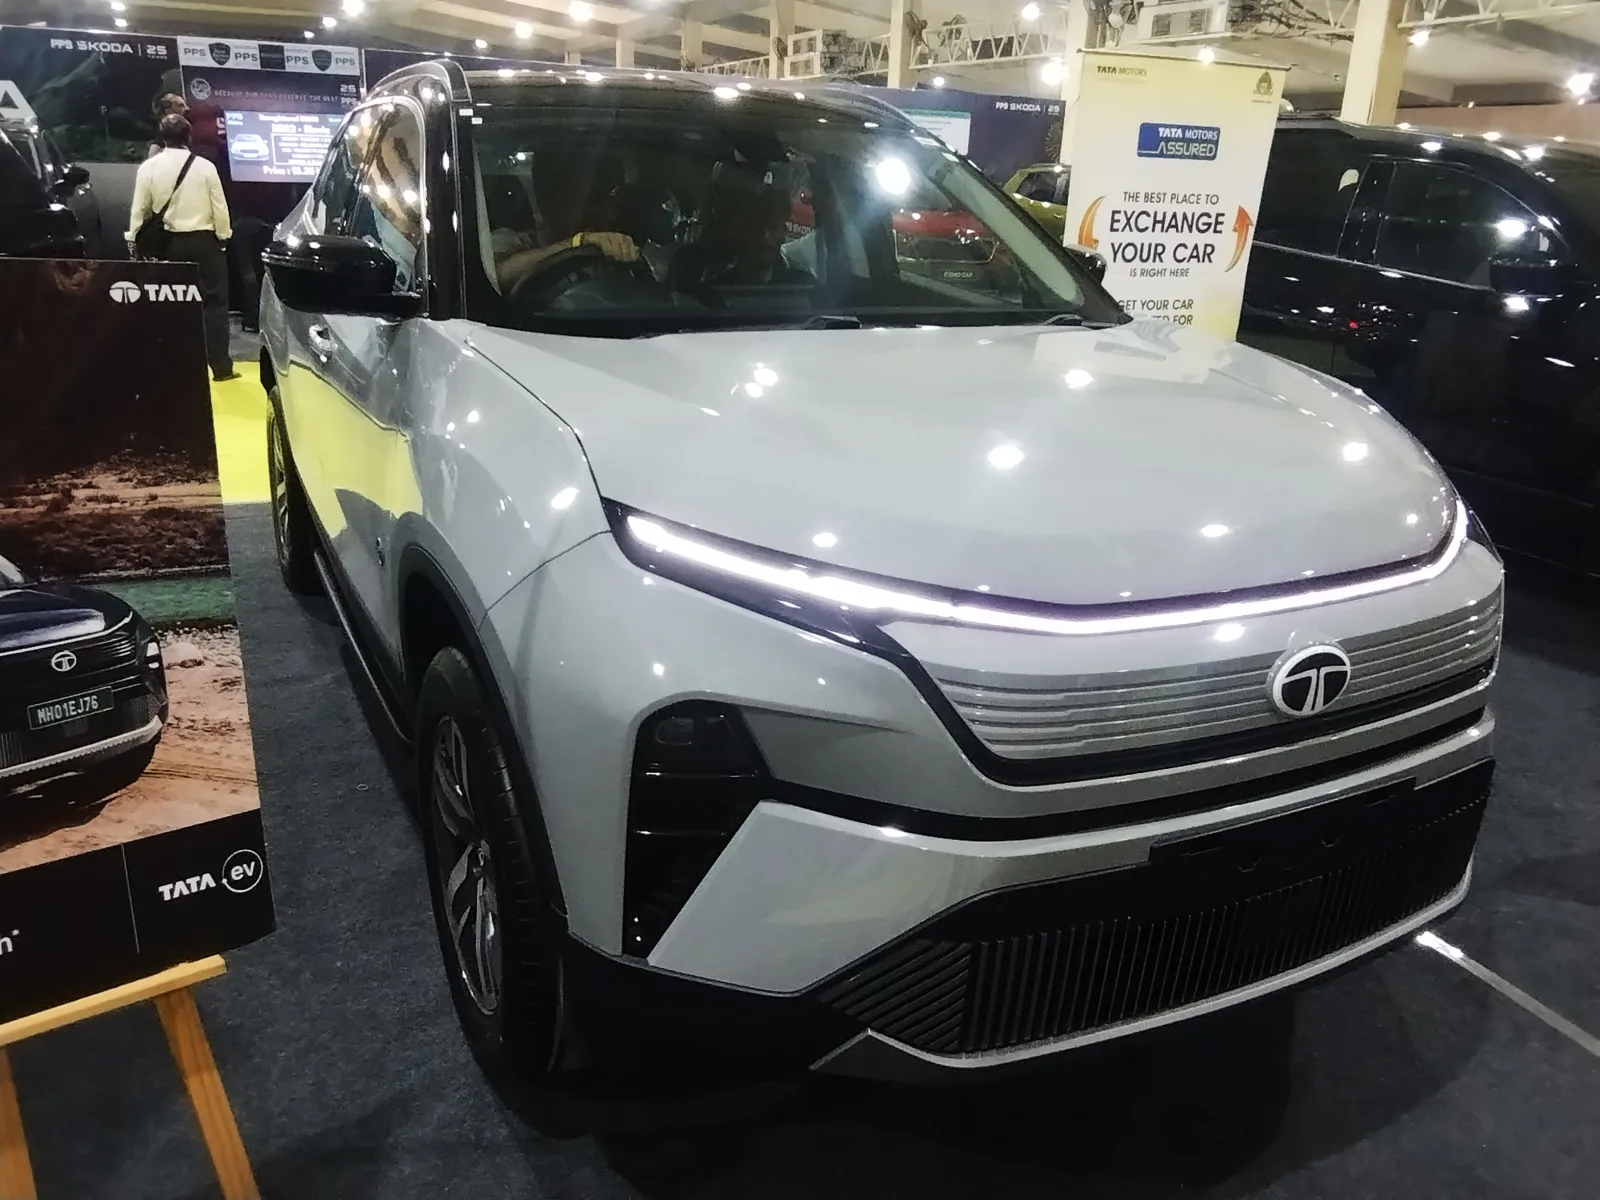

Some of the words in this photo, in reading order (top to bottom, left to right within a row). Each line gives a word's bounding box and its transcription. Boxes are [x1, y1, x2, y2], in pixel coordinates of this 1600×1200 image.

[146, 45, 168, 55] 25
[183, 47, 206, 57] PPS
[234, 52, 259, 62] PPS
[286, 55, 309, 65] PPS
[335, 57, 356, 66] PPS
[1097, 65, 1117, 75] TATA
[1118, 67, 1148, 77] MOTORS
[1158, 127, 1183, 138] TATA
[1184, 129, 1218, 141] MOTORS
[1157, 141, 1216, 156] ASSURED
[1123, 192, 1141, 202] THE
[1143, 192, 1167, 204] BEST
[1170, 193, 1202, 205] PLACE
[1205, 194, 1219, 205] TO
[1110, 210, 1225, 234] EXCHANGE
[1110, 242, 1167, 263] YOUR
[1172, 243, 1216, 264] CAR
[1129, 268, 1138, 278] IS
[1139, 268, 1168, 278] RIGHT
[1169, 268, 1191, 278] HERE
[143, 284, 203, 302] TATA
[1118, 300, 1138, 311] GET
[1140, 300, 1170, 311] YOUR
[1172, 299, 1194, 310] CAR
[1172, 314, 1194, 326] FOR
[37, 695, 98, 724] MH01EJ76
[158, 872, 217, 901] TATA
[230, 861, 256, 881] ev
